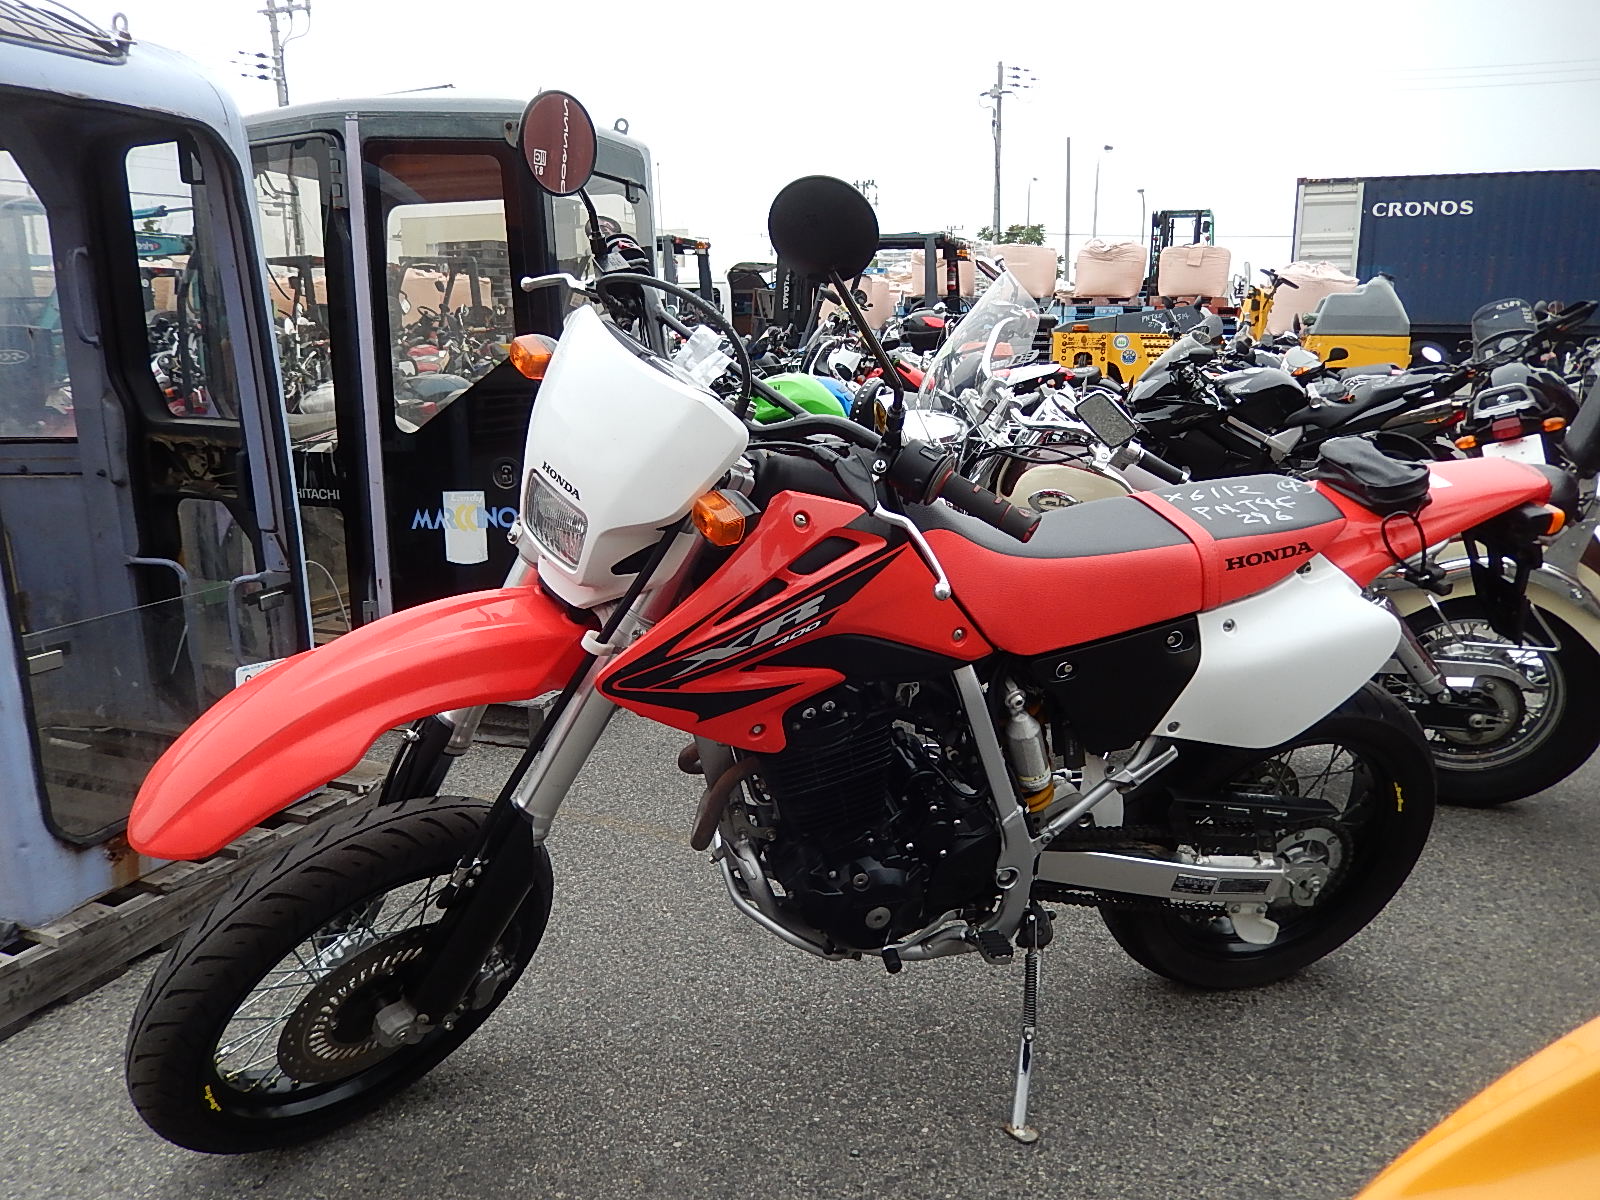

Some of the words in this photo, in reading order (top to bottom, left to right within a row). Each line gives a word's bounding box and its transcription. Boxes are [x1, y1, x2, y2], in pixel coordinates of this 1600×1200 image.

[1372, 200, 1474, 217] CRONOS
[543, 461, 581, 501] HONDA
[1225, 541, 1314, 572] HONDA
[670, 594, 827, 679] XR
[774, 620, 823, 647] 400
